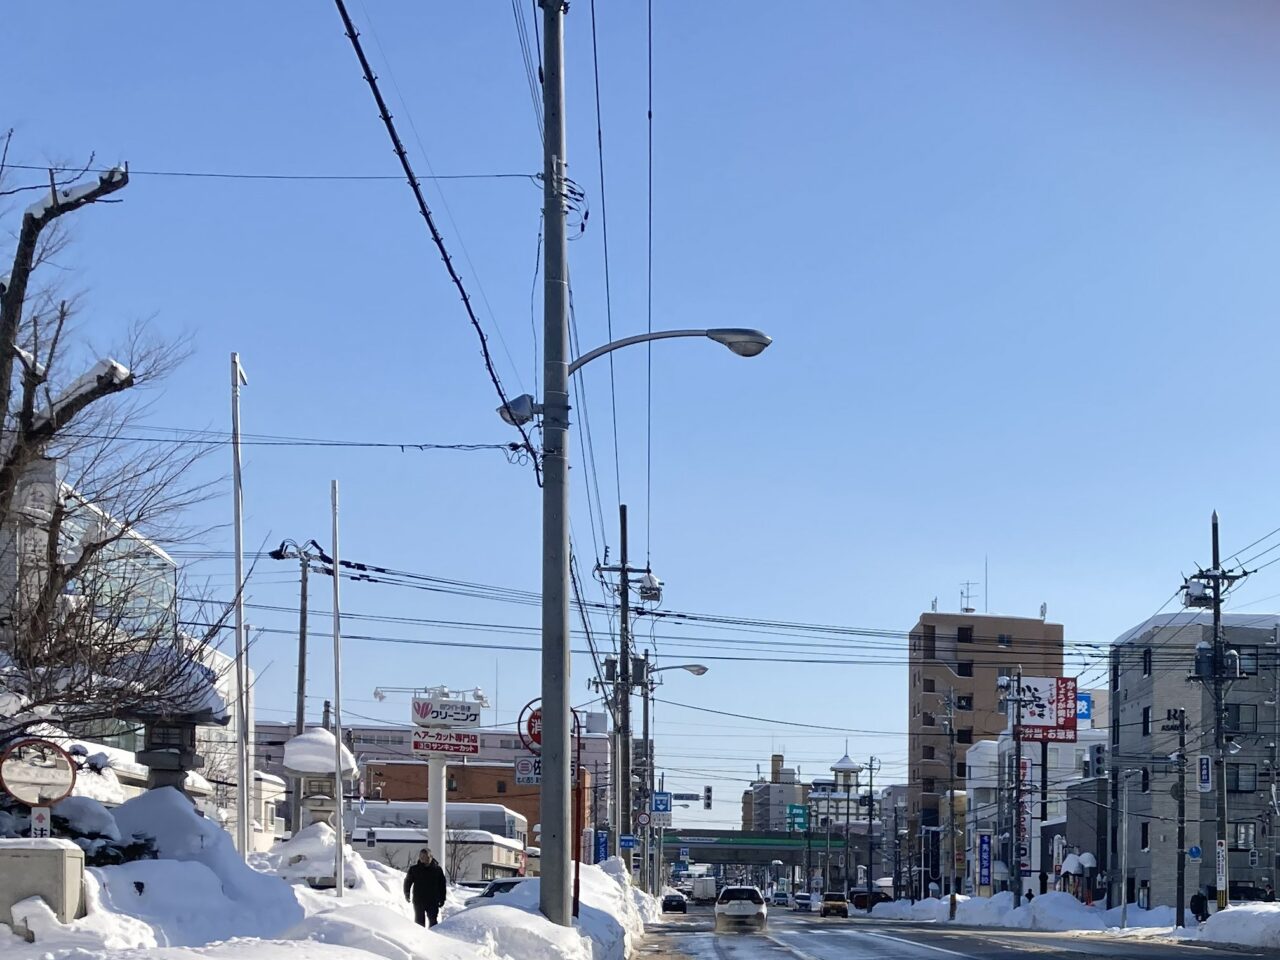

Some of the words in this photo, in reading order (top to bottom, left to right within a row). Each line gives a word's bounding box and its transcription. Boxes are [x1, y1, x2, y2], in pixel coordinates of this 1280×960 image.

[1066, 680, 1076, 718] からあげ
[431, 710, 479, 722] クリーニング
[414, 730, 478, 744] ヘアーカット専門店
